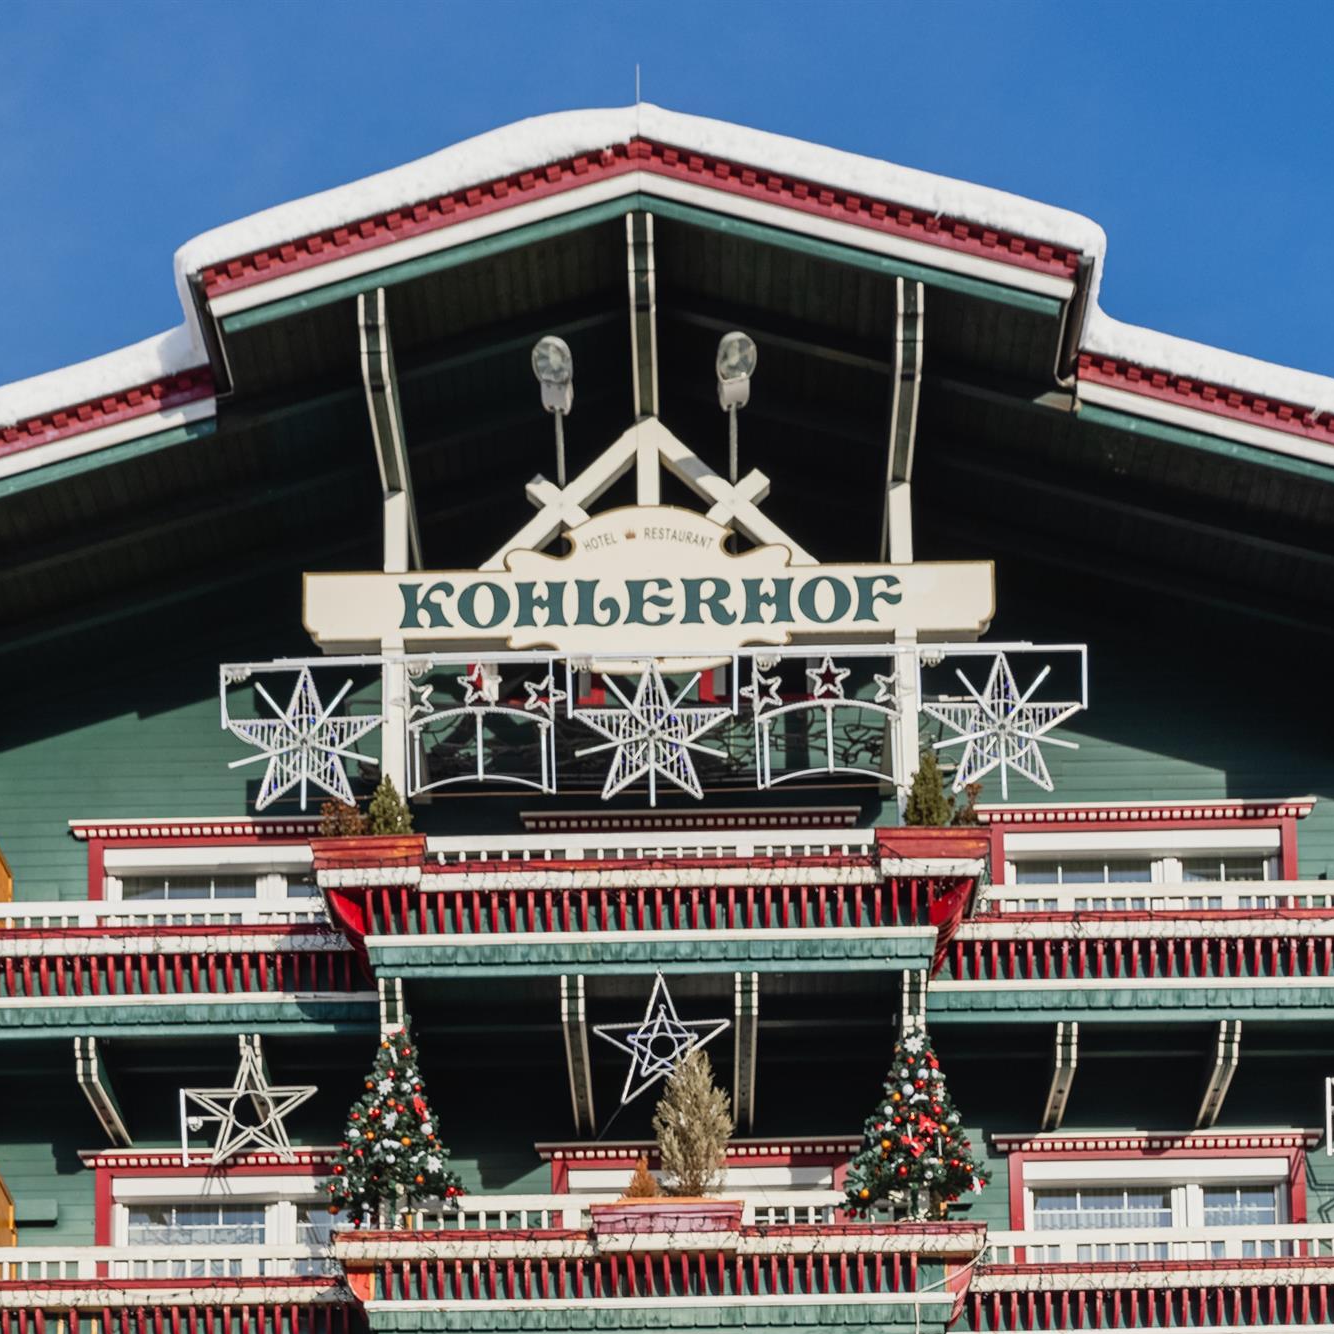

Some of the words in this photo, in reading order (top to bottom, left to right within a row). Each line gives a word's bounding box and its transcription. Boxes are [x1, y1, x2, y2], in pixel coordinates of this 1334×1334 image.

[583, 531, 618, 551] HOTEL
[644, 527, 714, 549] RESTAURANT
[398, 574, 903, 629] KOHLERHOF
